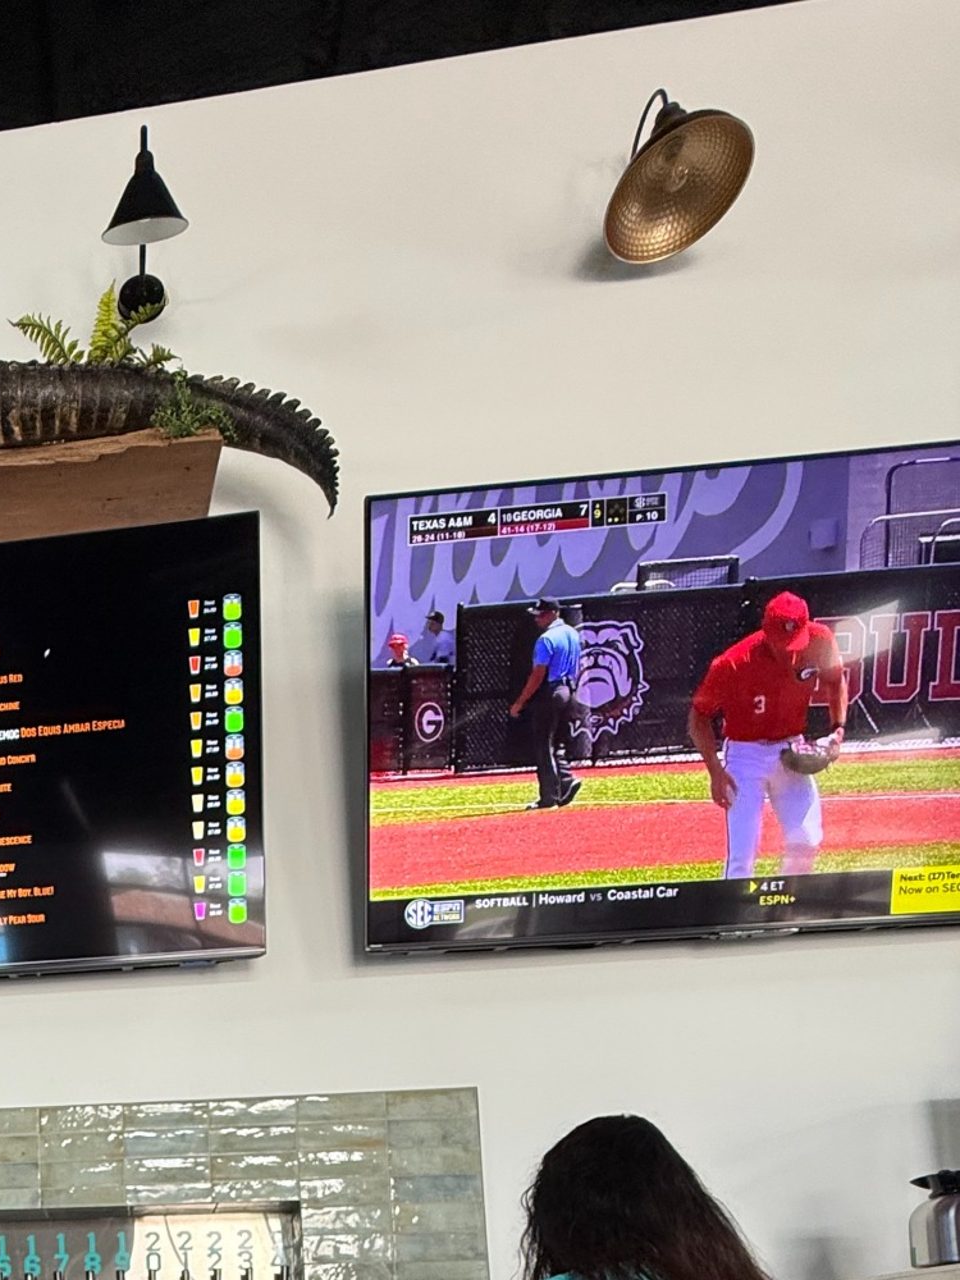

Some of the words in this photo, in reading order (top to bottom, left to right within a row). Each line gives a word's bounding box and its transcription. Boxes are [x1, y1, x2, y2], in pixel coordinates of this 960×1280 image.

[411, 518, 446, 531] TEXAS
[447, 516, 473, 528] A&M
[487, 512, 496, 524] 4
[502, 513, 512, 523] 10
[513, 508, 563, 522] GEORGIA
[579, 505, 588, 516] 7
[594, 508, 601, 518] 9
[645, 510, 659, 521] 10
[501, 524, 525, 535] 41-14
[526, 521, 556, 533] (17-12)
[8, 673, 23, 684] RED
[753, 694, 766, 714] 3
[415, 701, 445, 742] G
[20, 727, 37, 738] DOS
[38, 725, 62, 737] EQUIS
[63, 722, 90, 735] AMBAR
[899, 873, 926, 882] Next:
[759, 882, 768, 890] 4
[770, 881, 785, 890] ET
[899, 885, 921, 894] Now
[406, 900, 432, 927] SEC
[475, 896, 529, 909] SOFTBALL
[539, 891, 585, 904] Howard
[589, 892, 603, 902] vs
[607, 887, 654, 901] Coastal
[656, 885, 678, 898] Car
[759, 894, 796, 906] ESPN+
